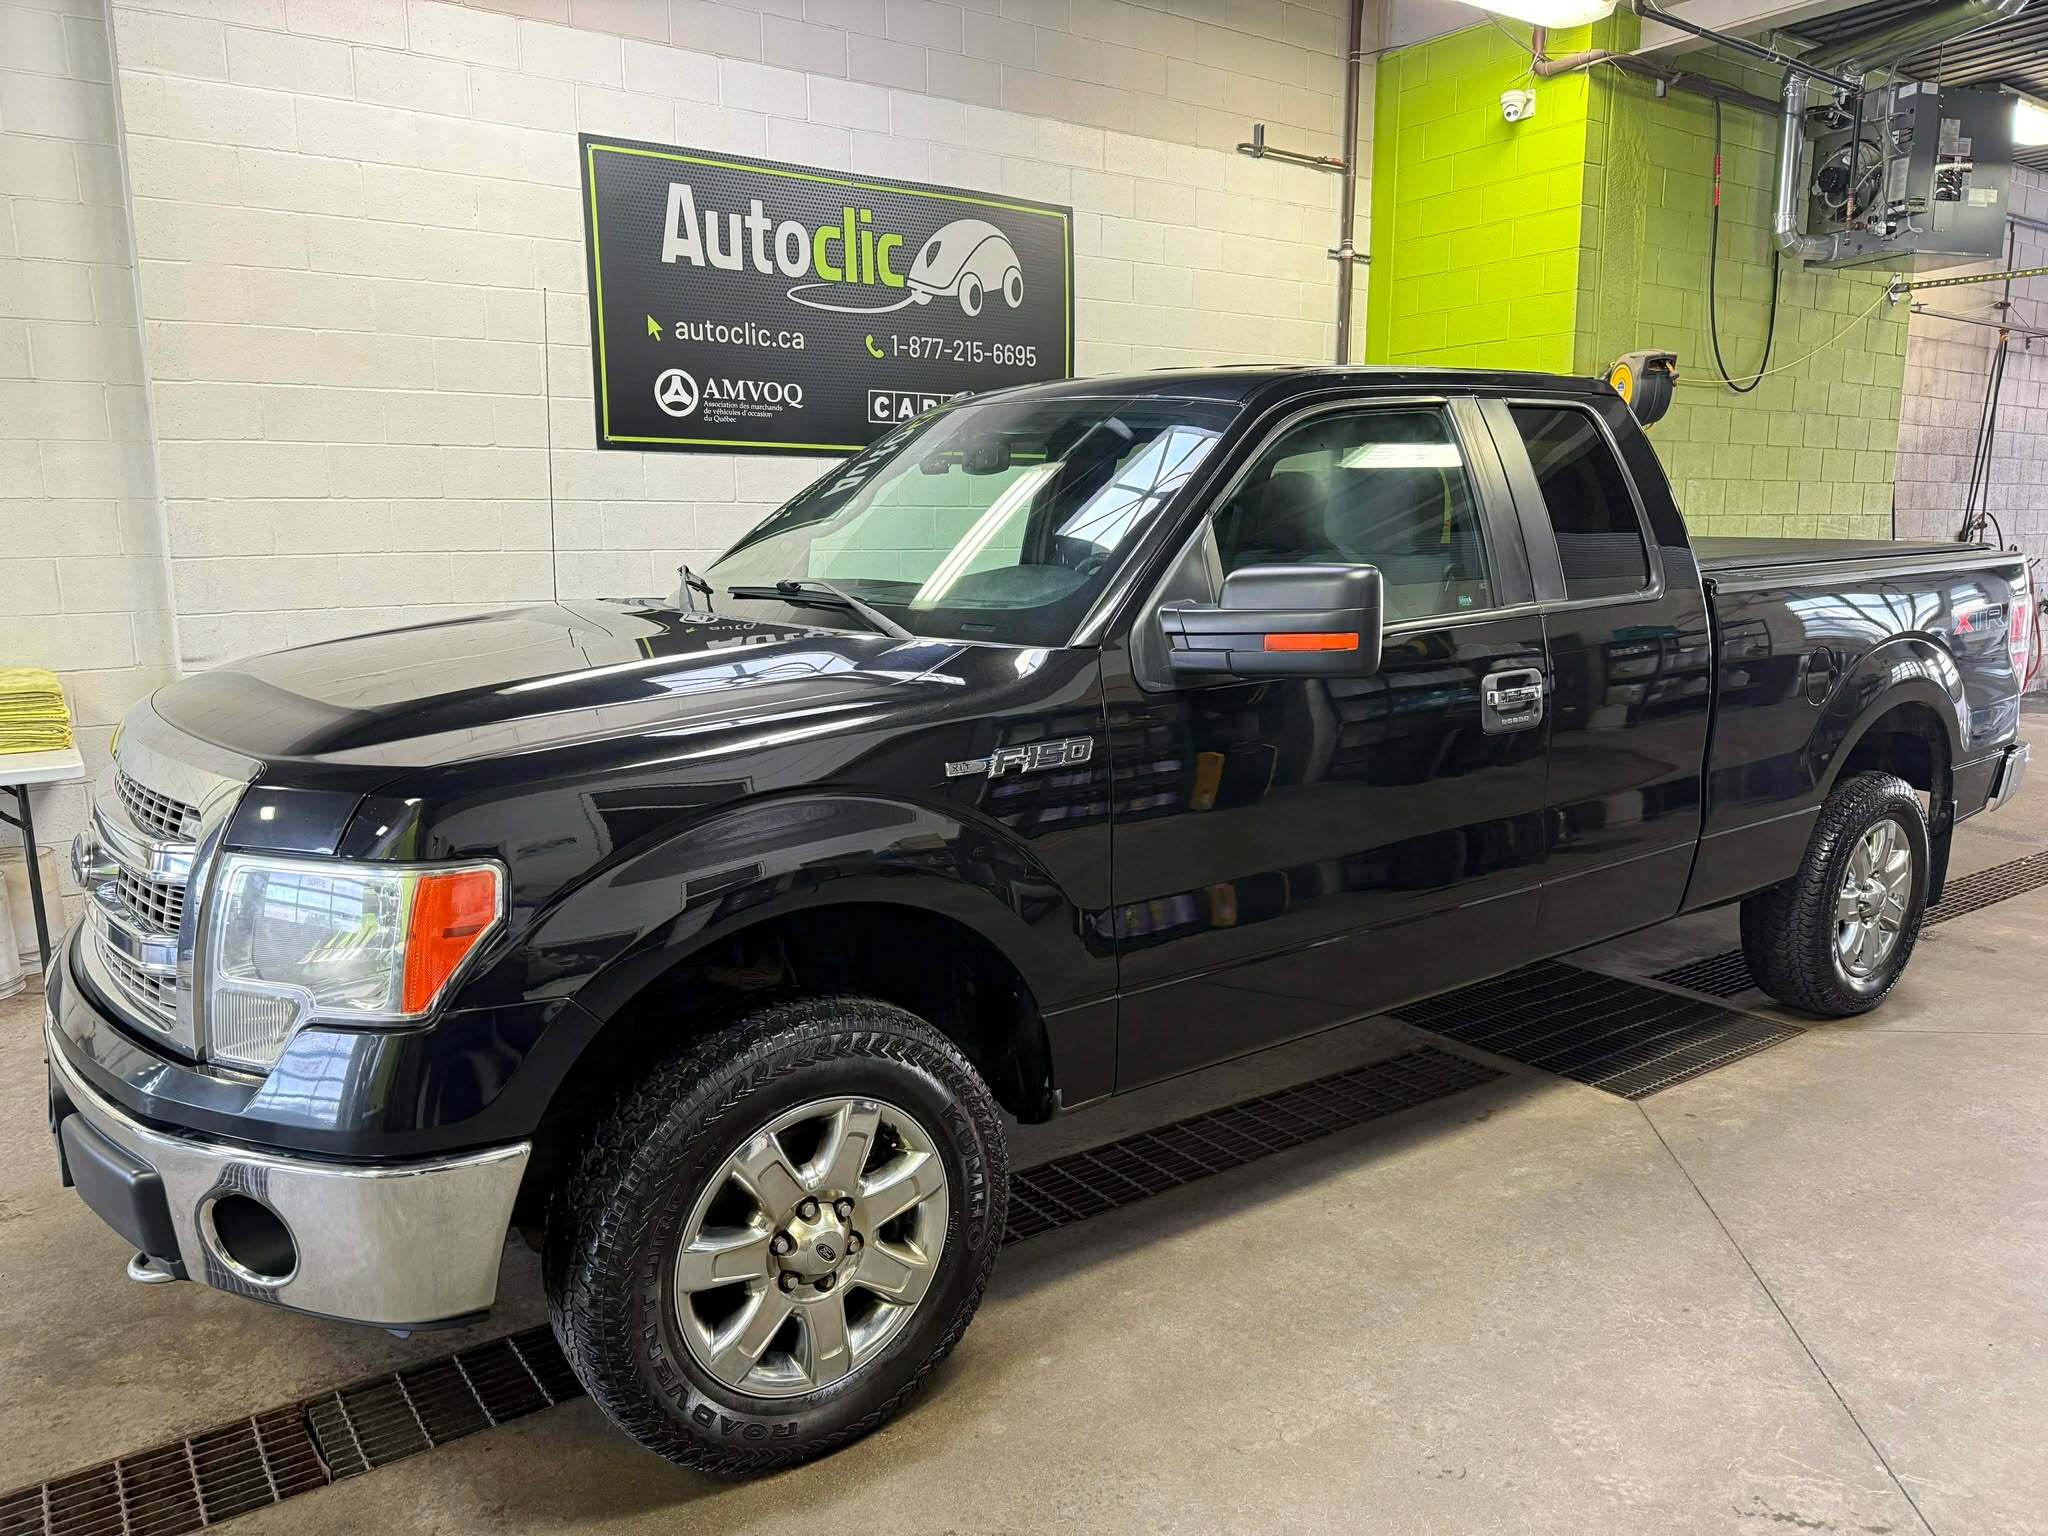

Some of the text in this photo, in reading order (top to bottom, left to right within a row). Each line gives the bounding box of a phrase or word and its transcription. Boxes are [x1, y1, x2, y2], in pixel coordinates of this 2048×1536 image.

[661, 182, 905, 288] Autoclic
[675, 320, 805, 350] autoclic.ca
[890, 334, 1037, 367] 1-877-215-6695
[703, 378, 804, 409] AMVOQ
[703, 400, 783, 412] Association des marchands
[703, 407, 712, 415] de
[712, 408, 741, 416] véhicules
[703, 414, 737, 424] du Québec
[939, 1103, 986, 1251] KUMHO
